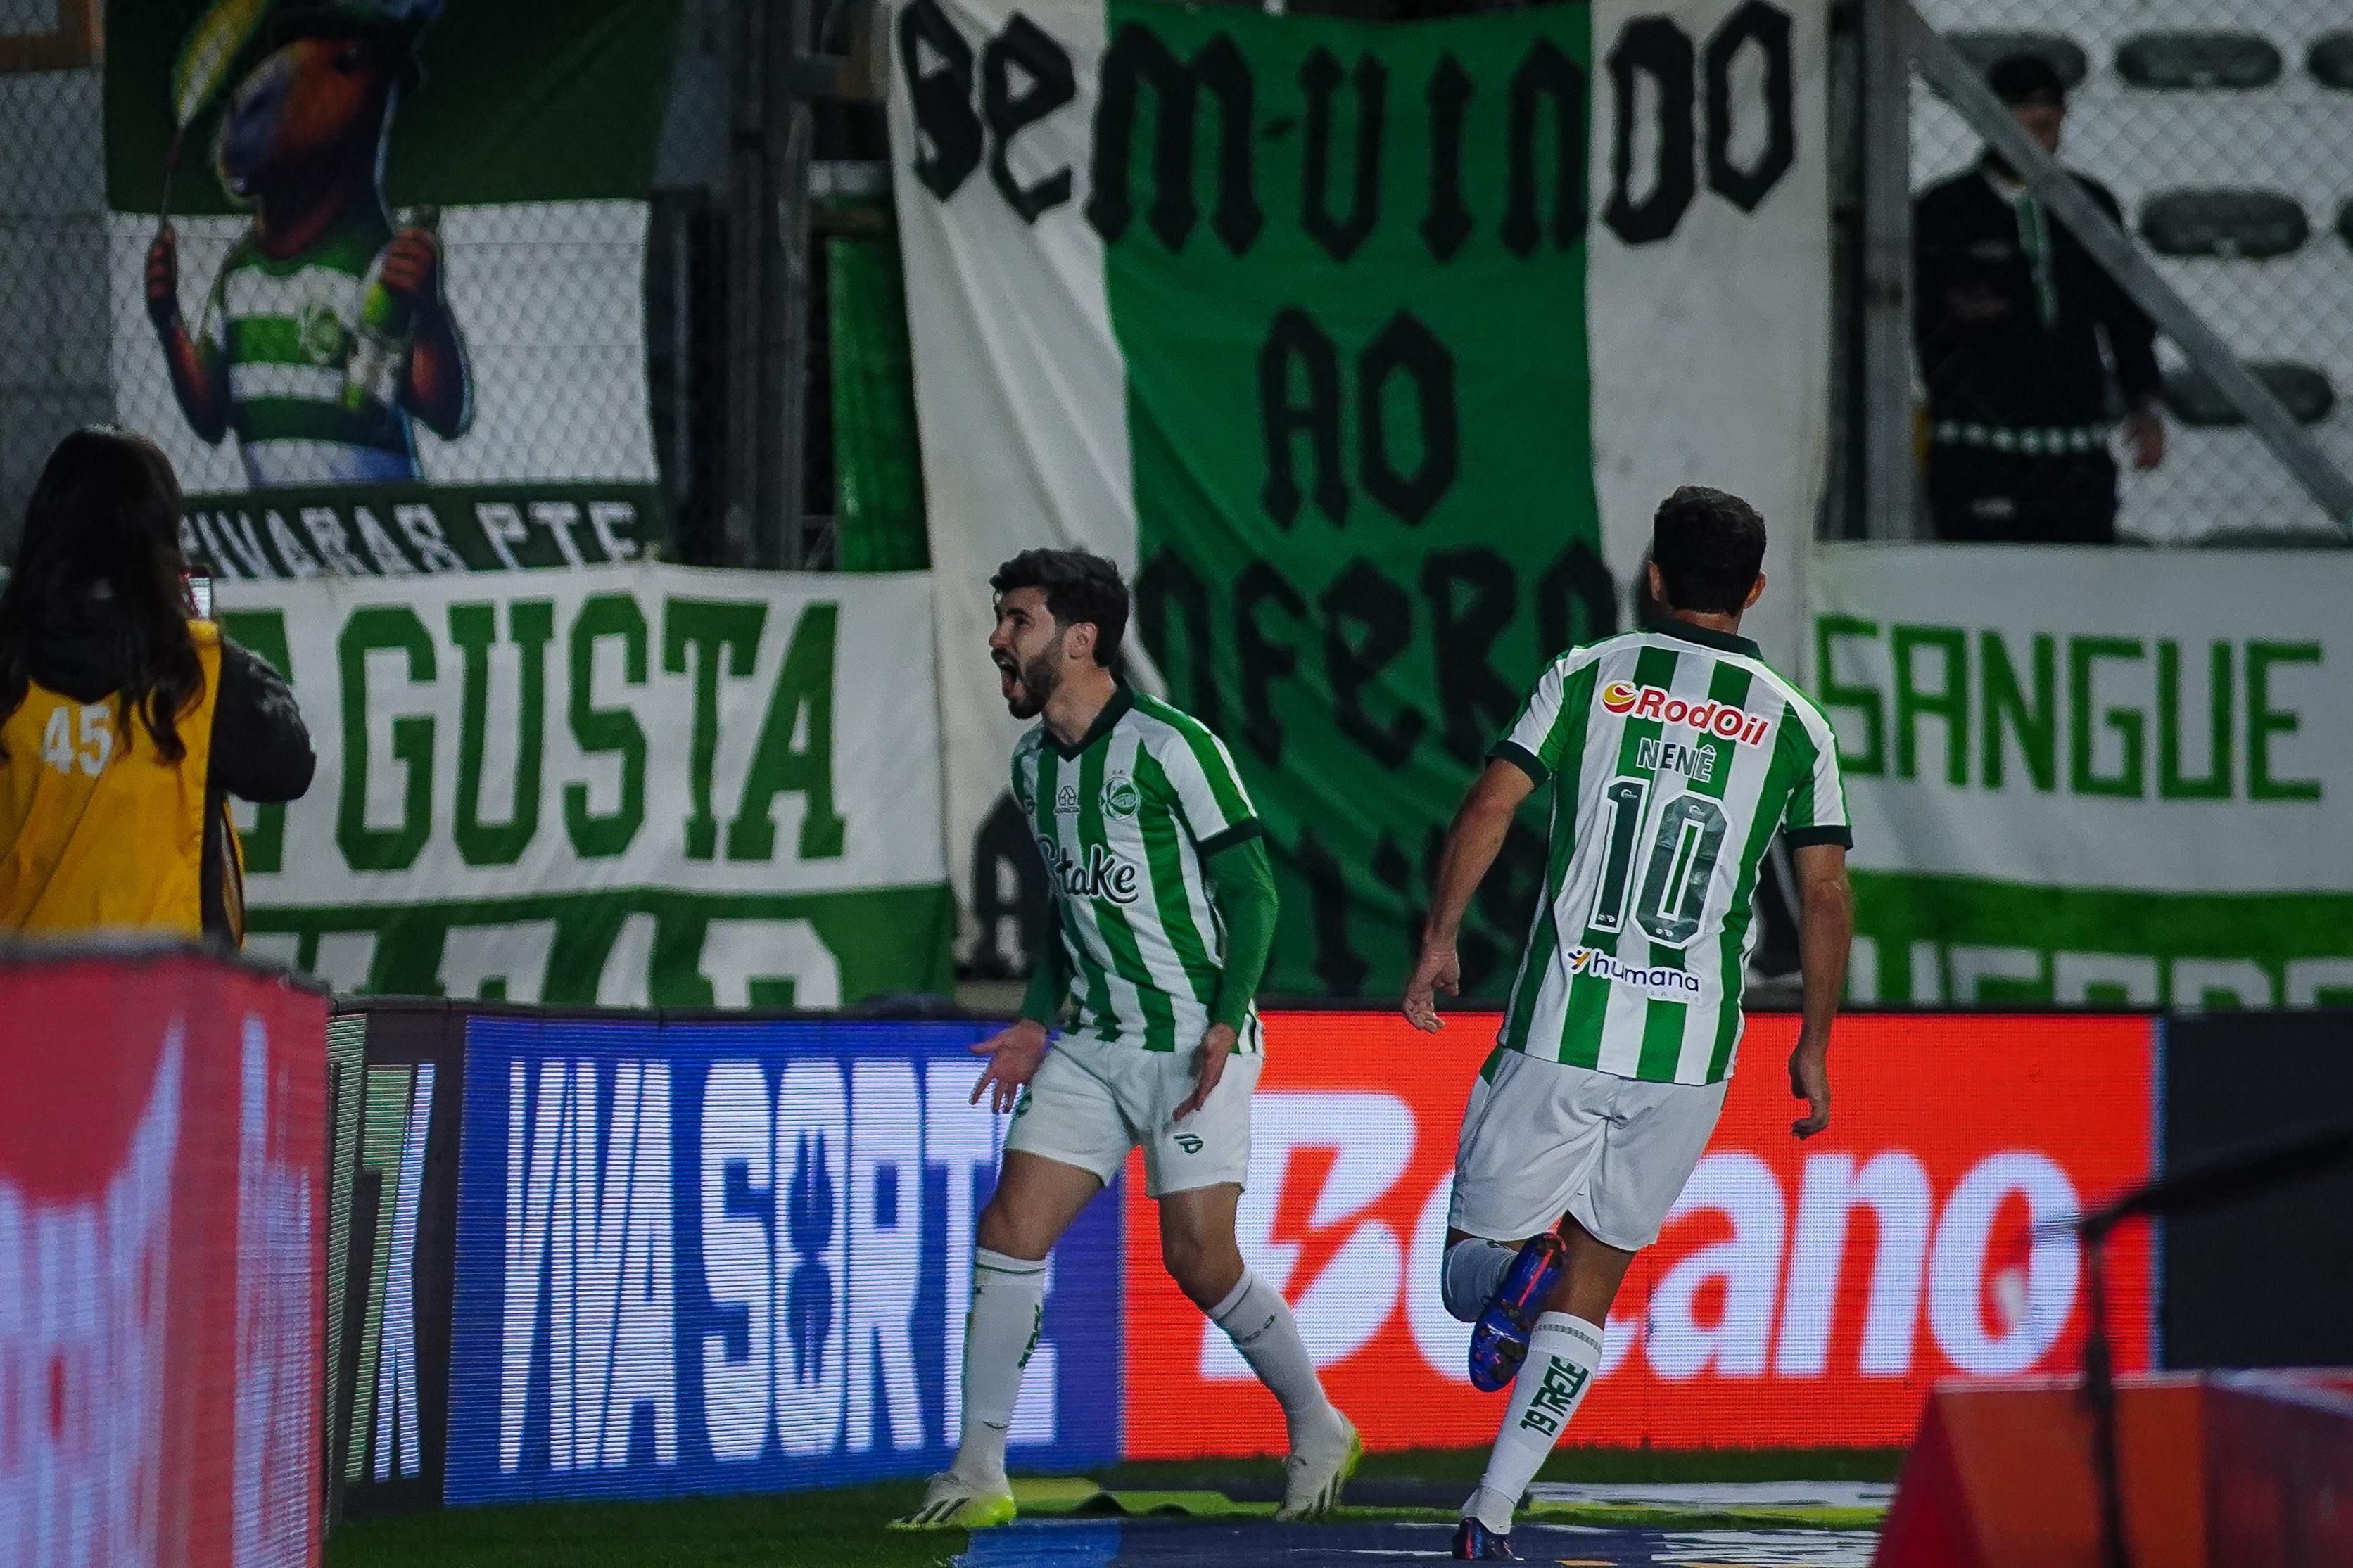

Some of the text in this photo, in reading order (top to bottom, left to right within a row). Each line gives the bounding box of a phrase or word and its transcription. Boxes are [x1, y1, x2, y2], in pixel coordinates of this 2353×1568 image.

[1257, 307, 1459, 530] AO
[41, 705, 113, 775] 45
[336, 591, 847, 872] GUSTA
[1636, 688, 1770, 746] RodOil
[1636, 737, 1718, 783] NENÊ
[1815, 613, 2323, 802] SANGUE
[1588, 775, 1732, 950] 10
[1593, 952, 1701, 993] humana
[498, 1057, 678, 1474] VIVA
[1198, 1090, 2085, 1384] Bano
